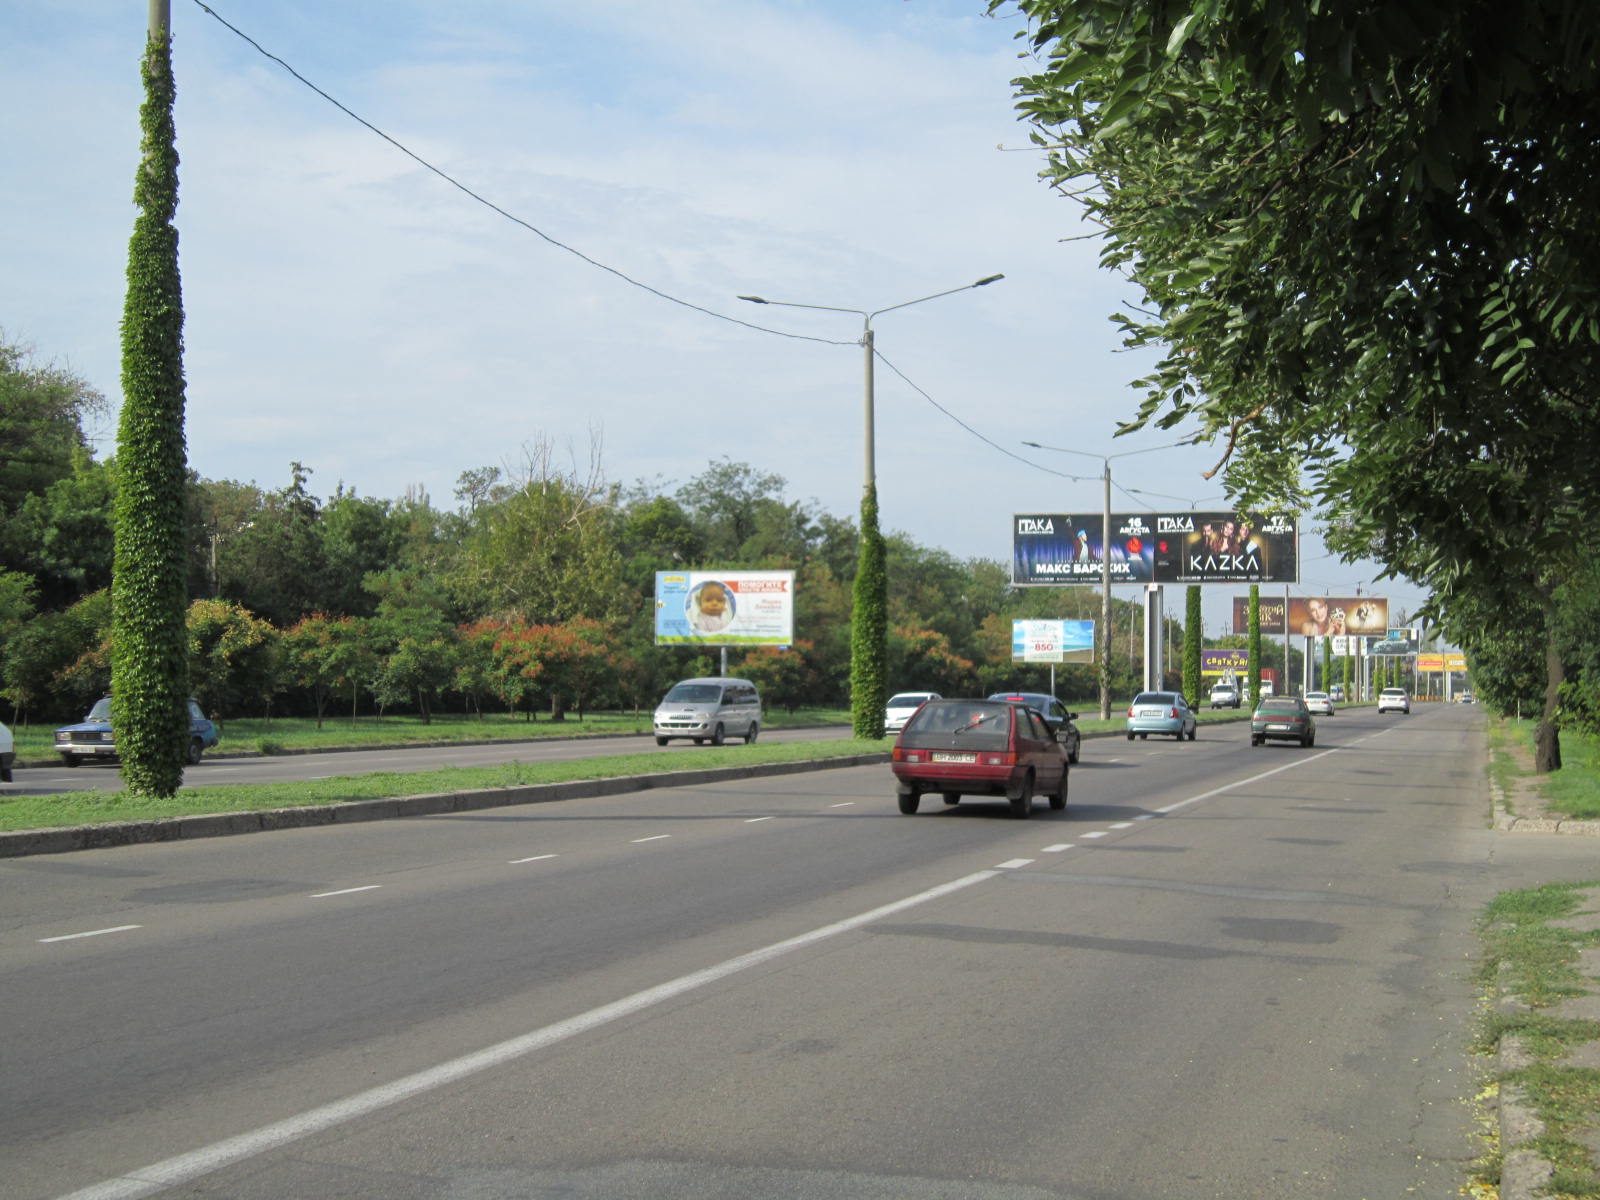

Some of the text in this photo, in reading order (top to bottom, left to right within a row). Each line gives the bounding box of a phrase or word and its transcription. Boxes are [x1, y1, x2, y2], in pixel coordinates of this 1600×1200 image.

[1127, 517, 1142, 527] 16
[1119, 526, 1150, 534] АВГУСТА
[1190, 555, 1259, 571] KAZKA
[1036, 563, 1071, 574] МАКС
[1034, 643, 1054, 651] 850
